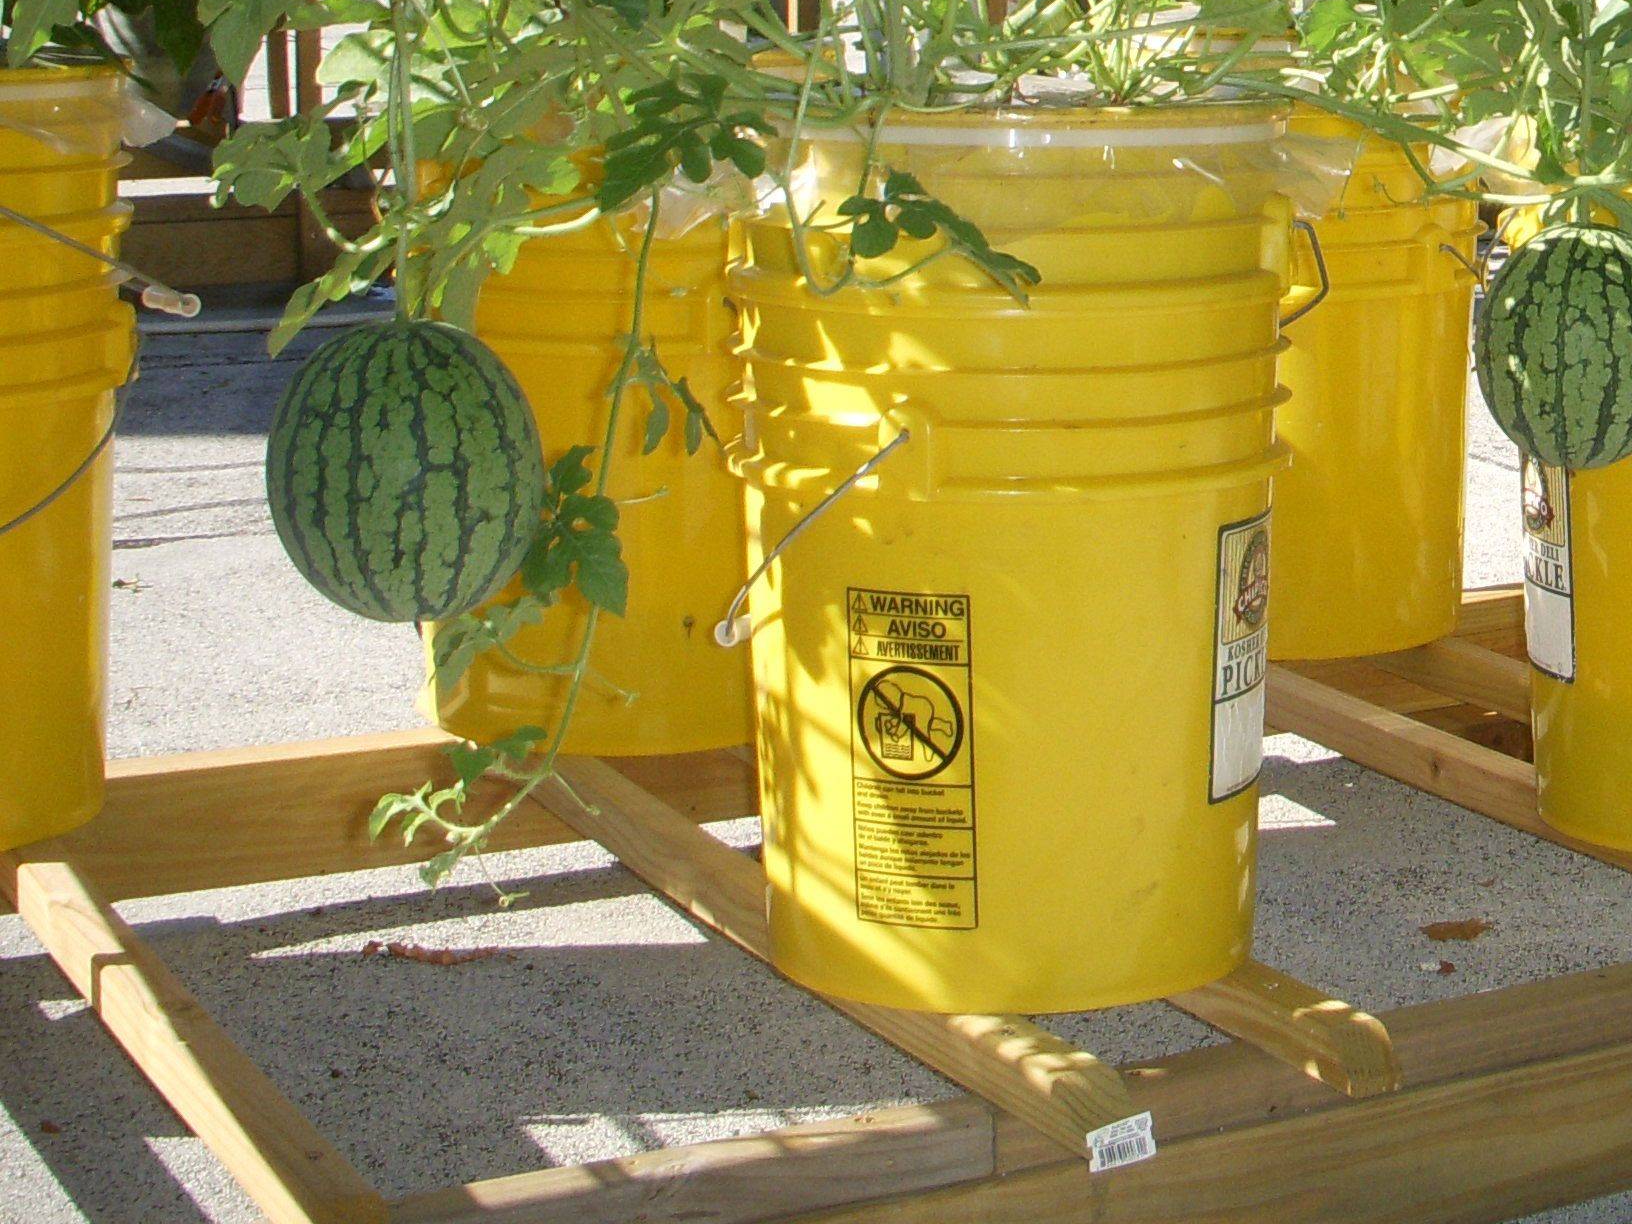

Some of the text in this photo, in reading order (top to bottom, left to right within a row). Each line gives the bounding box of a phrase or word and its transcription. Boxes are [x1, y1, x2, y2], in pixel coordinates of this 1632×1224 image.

[1541, 543, 1560, 562] DELI
[869, 595, 965, 617] WARNING
[887, 619, 947, 638] AVISO
[877, 641, 960, 661] AVERTISSEMENT
[1228, 634, 1260, 661] KOSHER
